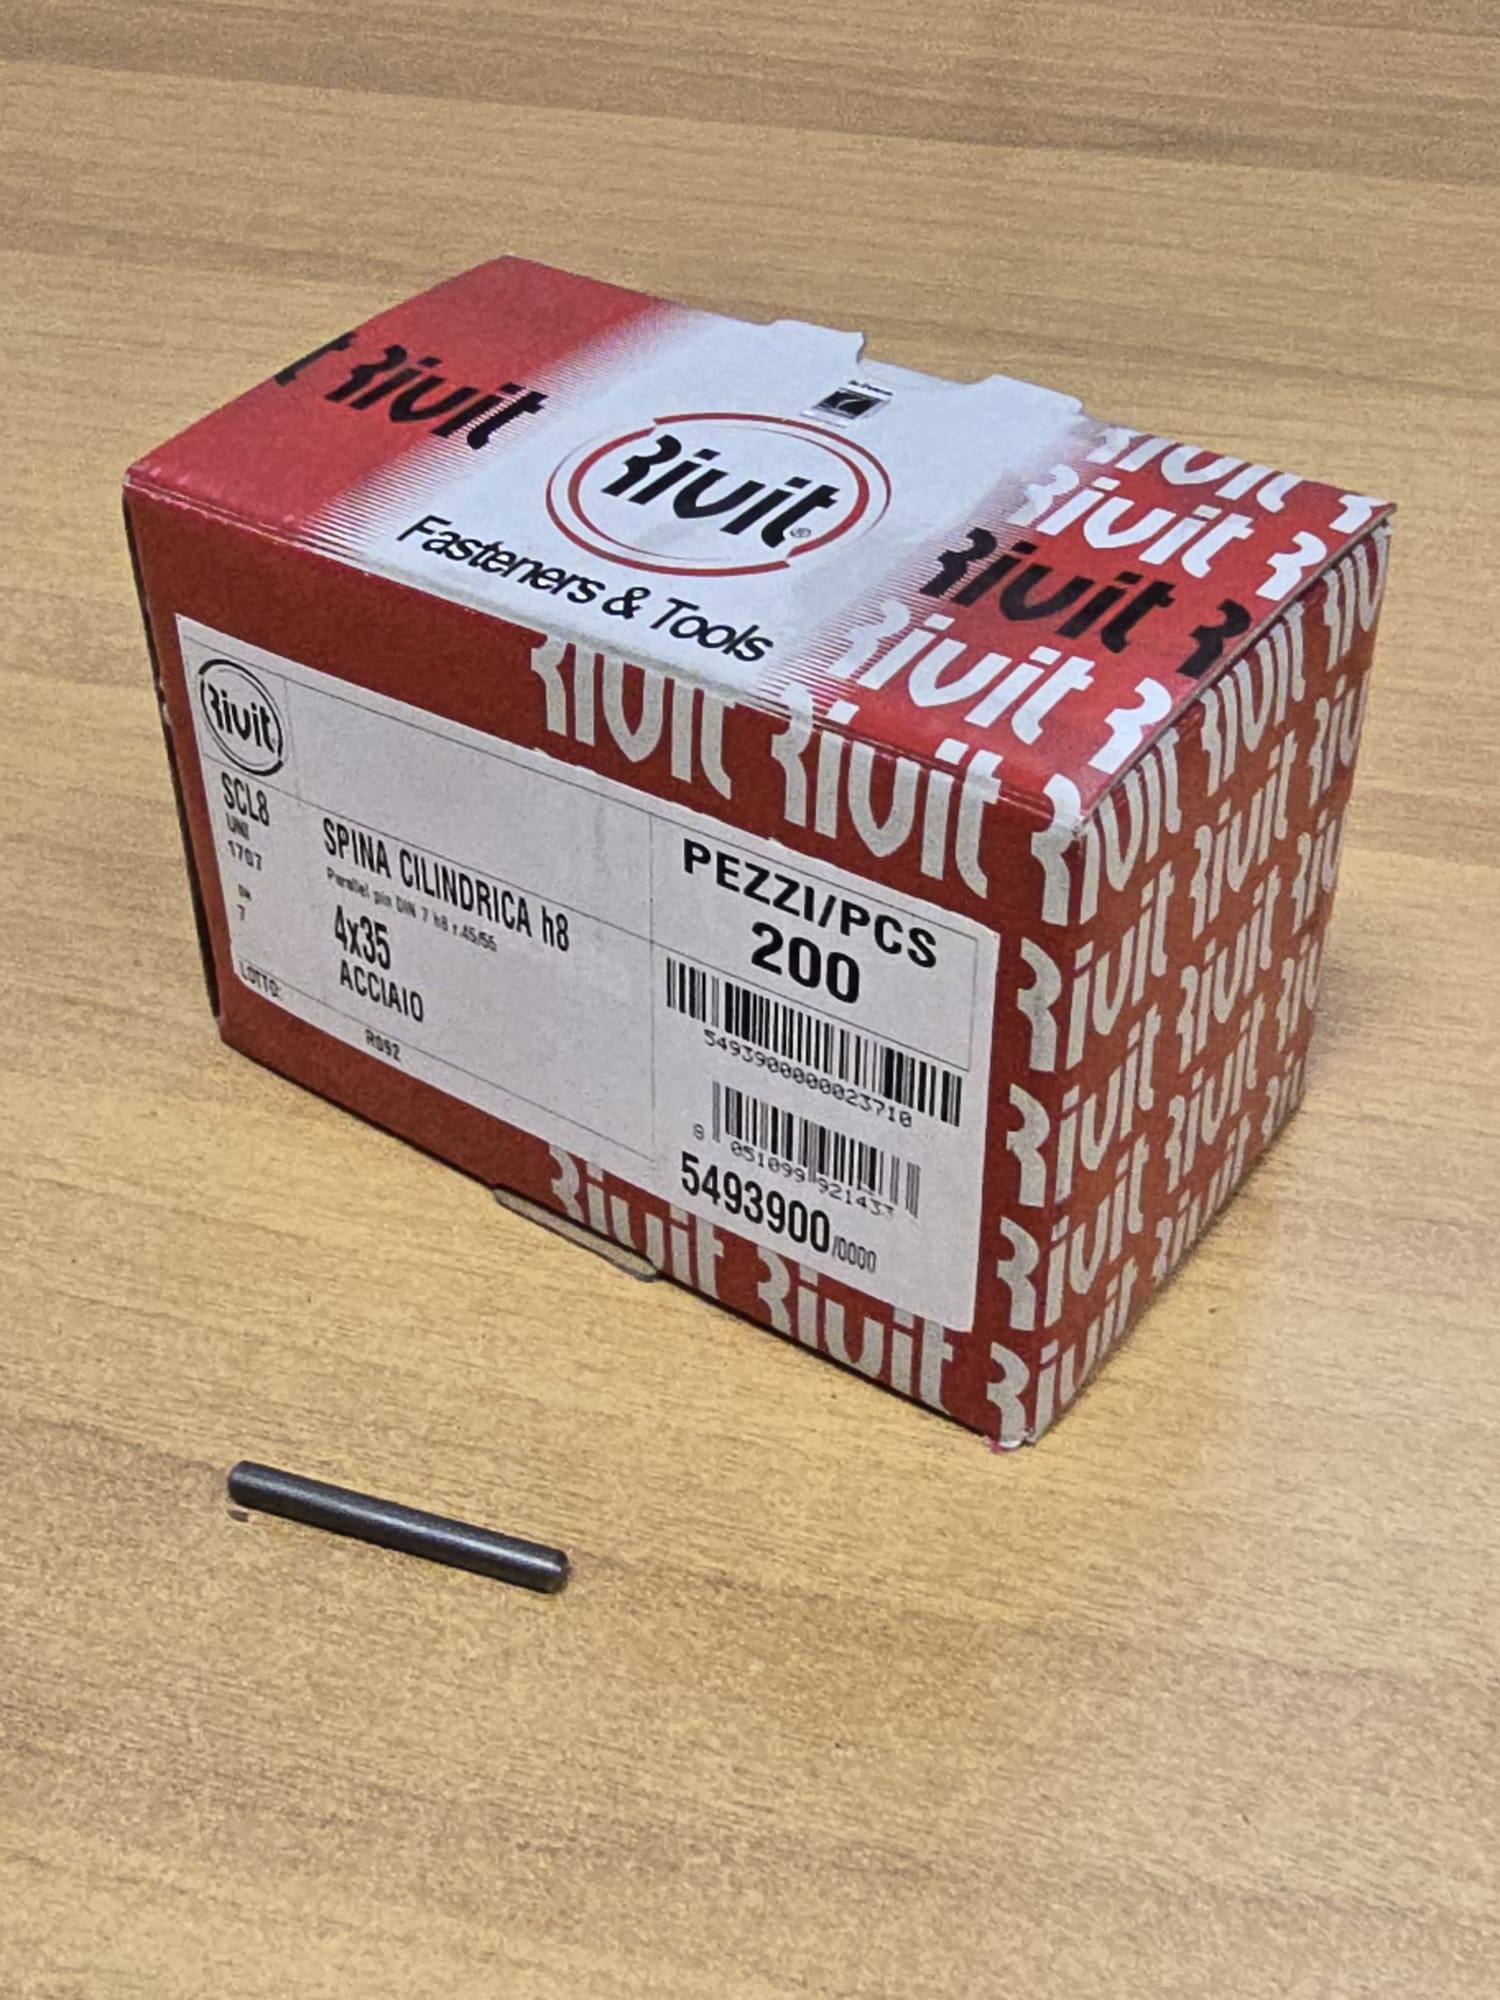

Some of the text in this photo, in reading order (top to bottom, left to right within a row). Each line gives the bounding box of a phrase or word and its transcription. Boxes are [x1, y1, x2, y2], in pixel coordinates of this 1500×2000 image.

[325, 344, 548, 450] Rivit
[1006, 466, 1254, 578] Rivit
[397, 515, 774, 662] Fasteners & Tools
[919, 528, 1175, 653] Rivit
[207, 683, 276, 753] Rivit
[827, 600, 1095, 745] Rivit
[221, 772, 270, 827] SCL8
[771, 682, 1002, 900] Rivit
[1190, 730, 1298, 942] Rivit
[227, 840, 263, 872] 1707
[323, 817, 570, 952] SPINA CILINDRICA h8
[395, 894, 417, 919] DIN
[683, 838, 938, 969] PEZZI/PCS
[334, 904, 392, 972] 4x35
[340, 959, 424, 1023] ACCIAIO
[751, 921, 861, 1005] 200
[1017, 862, 1175, 1073] Rivit
[1176, 865, 1281, 1074] Rivit
[703, 1028, 913, 1128] 5493900000023710
[1006, 1003, 1161, 1209] Rivit
[1165, 993, 1266, 1194] Rivit
[691, 1123, 705, 1142] 8
[731, 1140, 806, 1183] 051099
[997, 1133, 1149, 1331] Rivit
